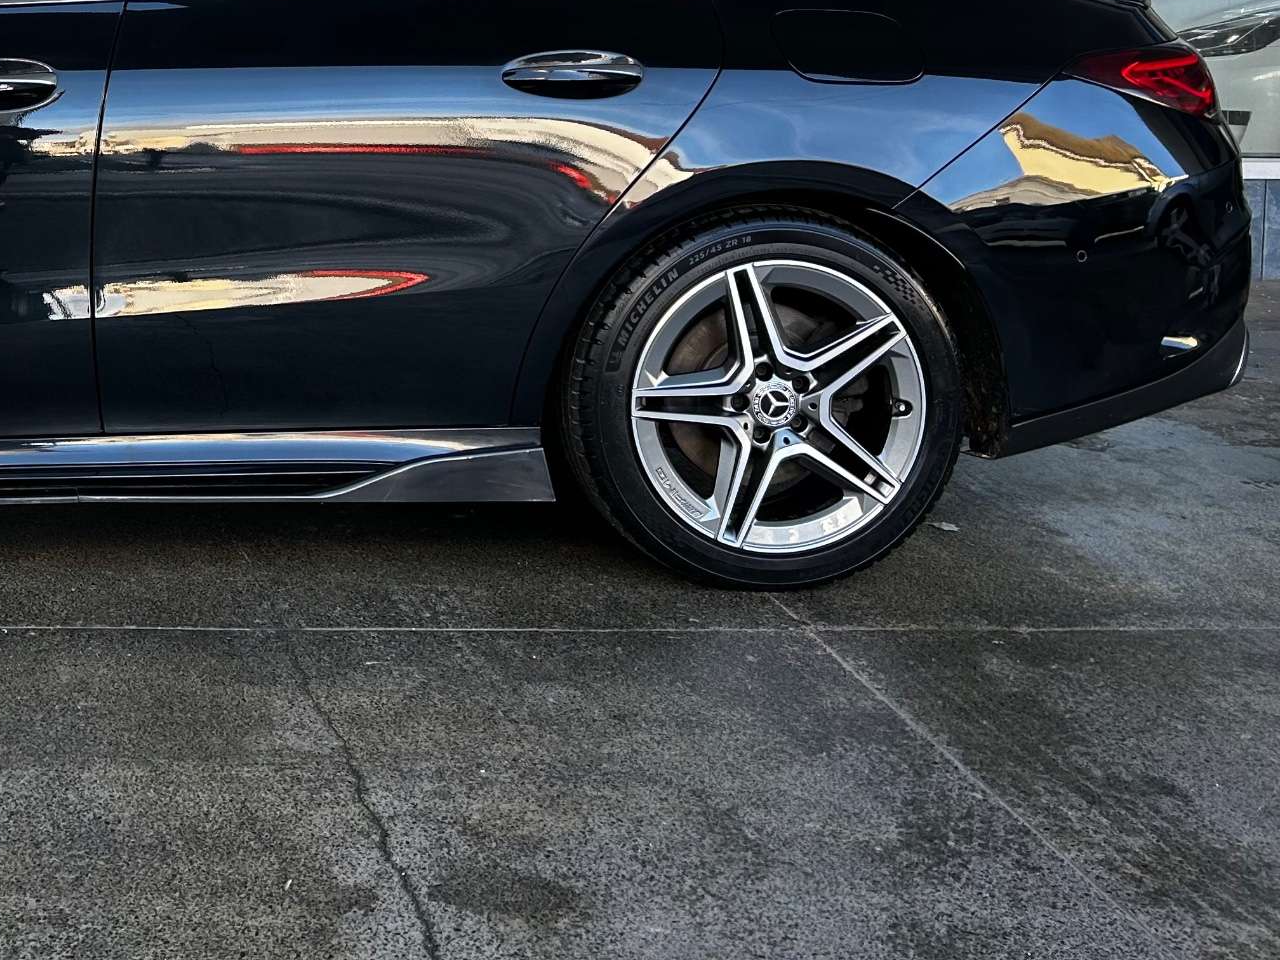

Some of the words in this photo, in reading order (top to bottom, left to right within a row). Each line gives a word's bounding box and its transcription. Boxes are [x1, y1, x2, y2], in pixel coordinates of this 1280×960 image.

[688, 244, 723, 265] 225/45
[725, 239, 738, 248] ZR
[617, 268, 680, 348] MICHELIN
